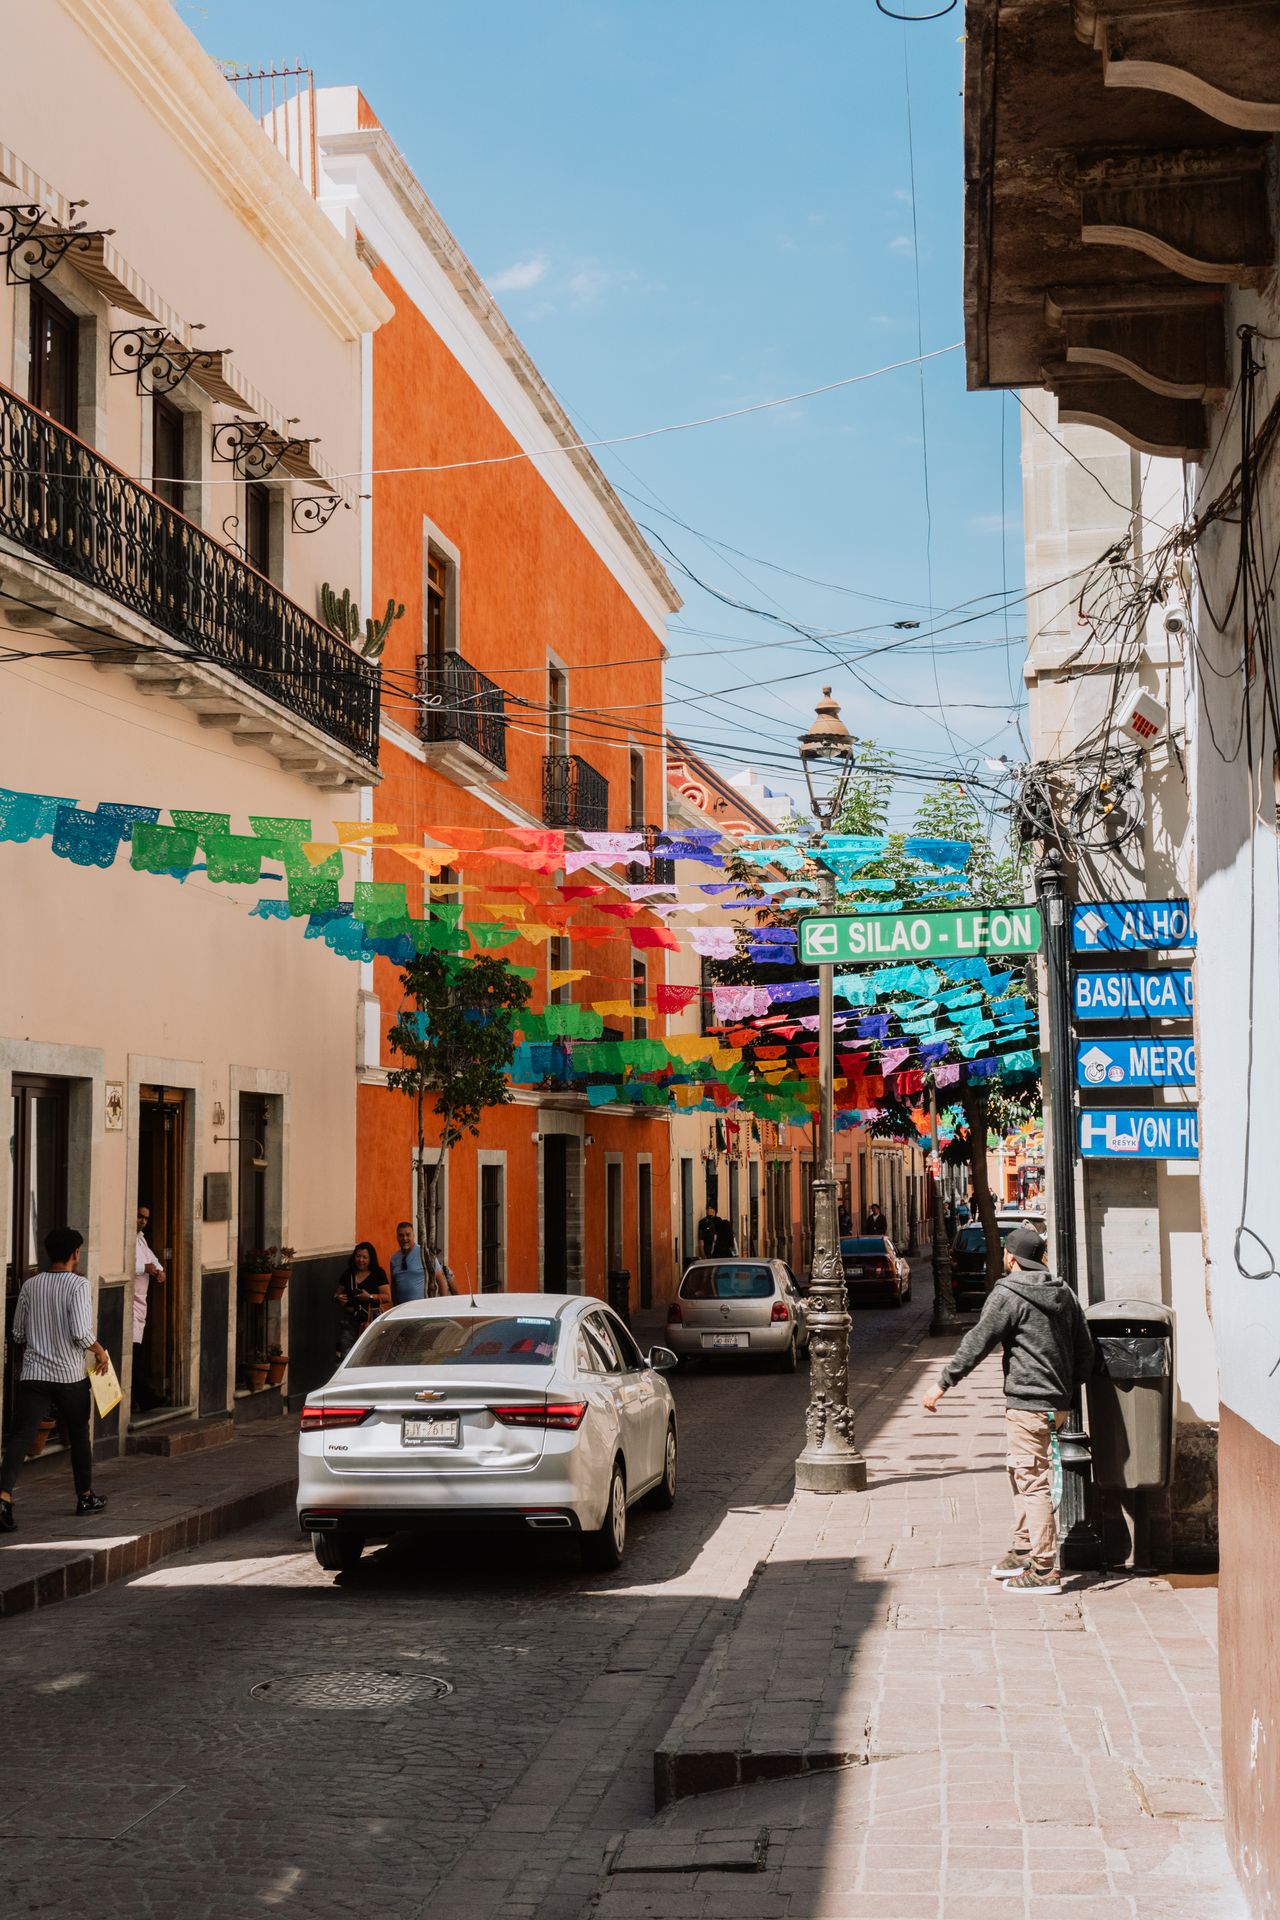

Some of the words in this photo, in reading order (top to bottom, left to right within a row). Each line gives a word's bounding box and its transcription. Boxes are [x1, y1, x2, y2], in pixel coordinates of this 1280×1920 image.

[848, 919, 931, 953] SILAO
[956, 914, 1032, 949] LEON
[1077, 976, 1177, 1007] BASILICA
[1112, 1139, 1137, 1147] RESYK
[1130, 1117, 1171, 1148] VON
